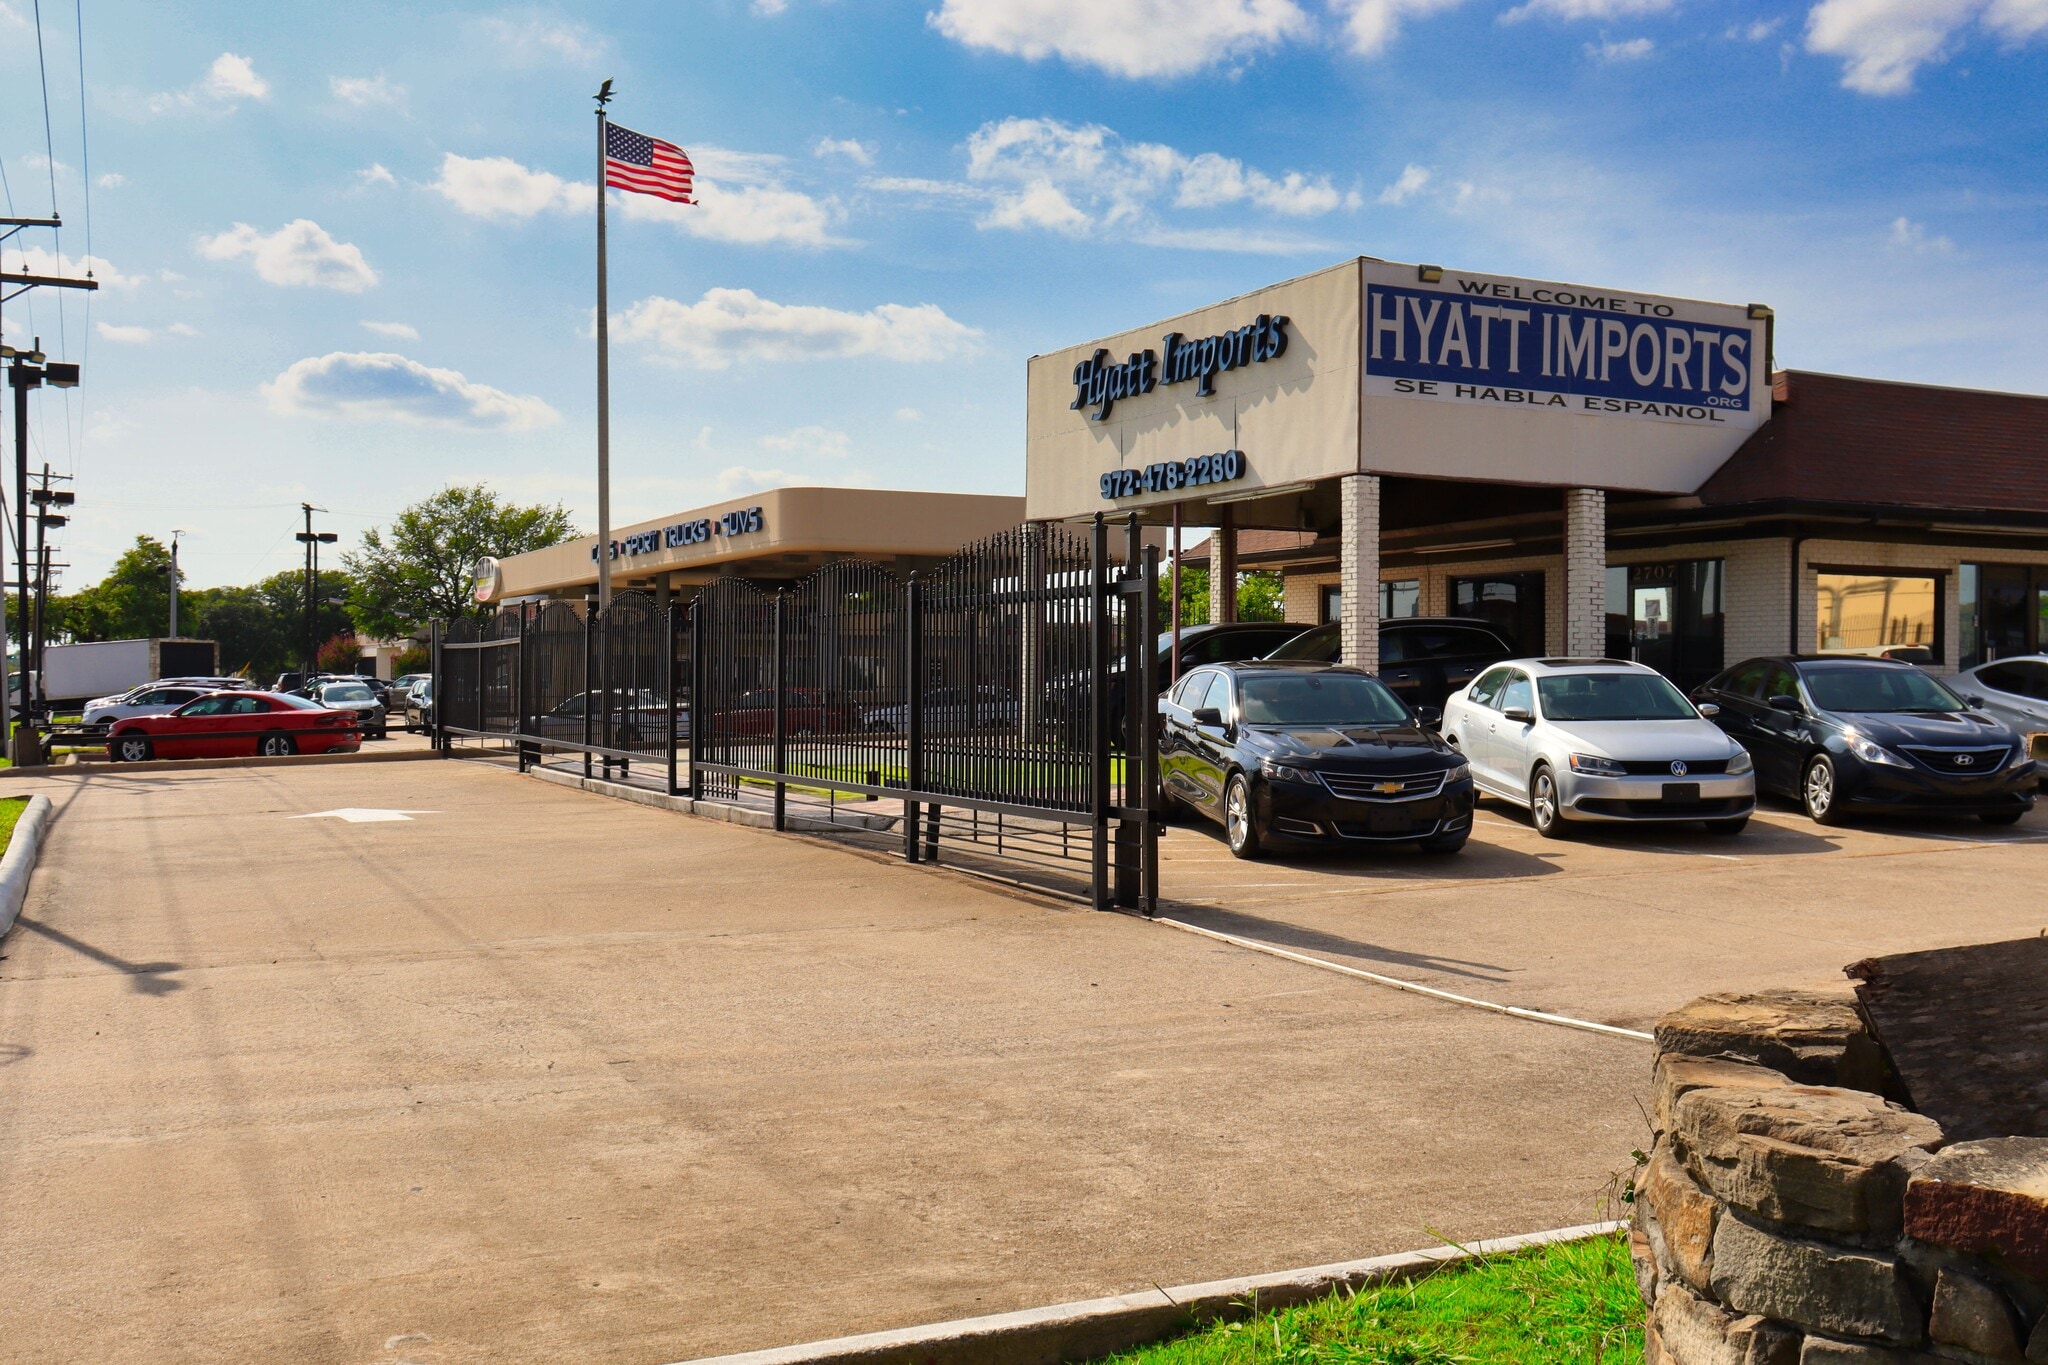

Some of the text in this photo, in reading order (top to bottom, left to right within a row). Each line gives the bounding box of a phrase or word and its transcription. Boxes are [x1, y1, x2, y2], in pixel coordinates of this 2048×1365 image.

[1457, 279, 1674, 318] WELCOME TO
[1069, 313, 1290, 421] Hyatt Imports
[1370, 292, 1748, 396] HYATT IMPORTS
[1393, 379, 1725, 422] SE HABLA ESPANOL
[1703, 396, 1742, 408] .ORG
[1100, 449, 1246, 499] 972-478-2280
[591, 506, 763, 564] CS SPORT TRUCKS SUVS
[1632, 565, 1676, 581] 2707
